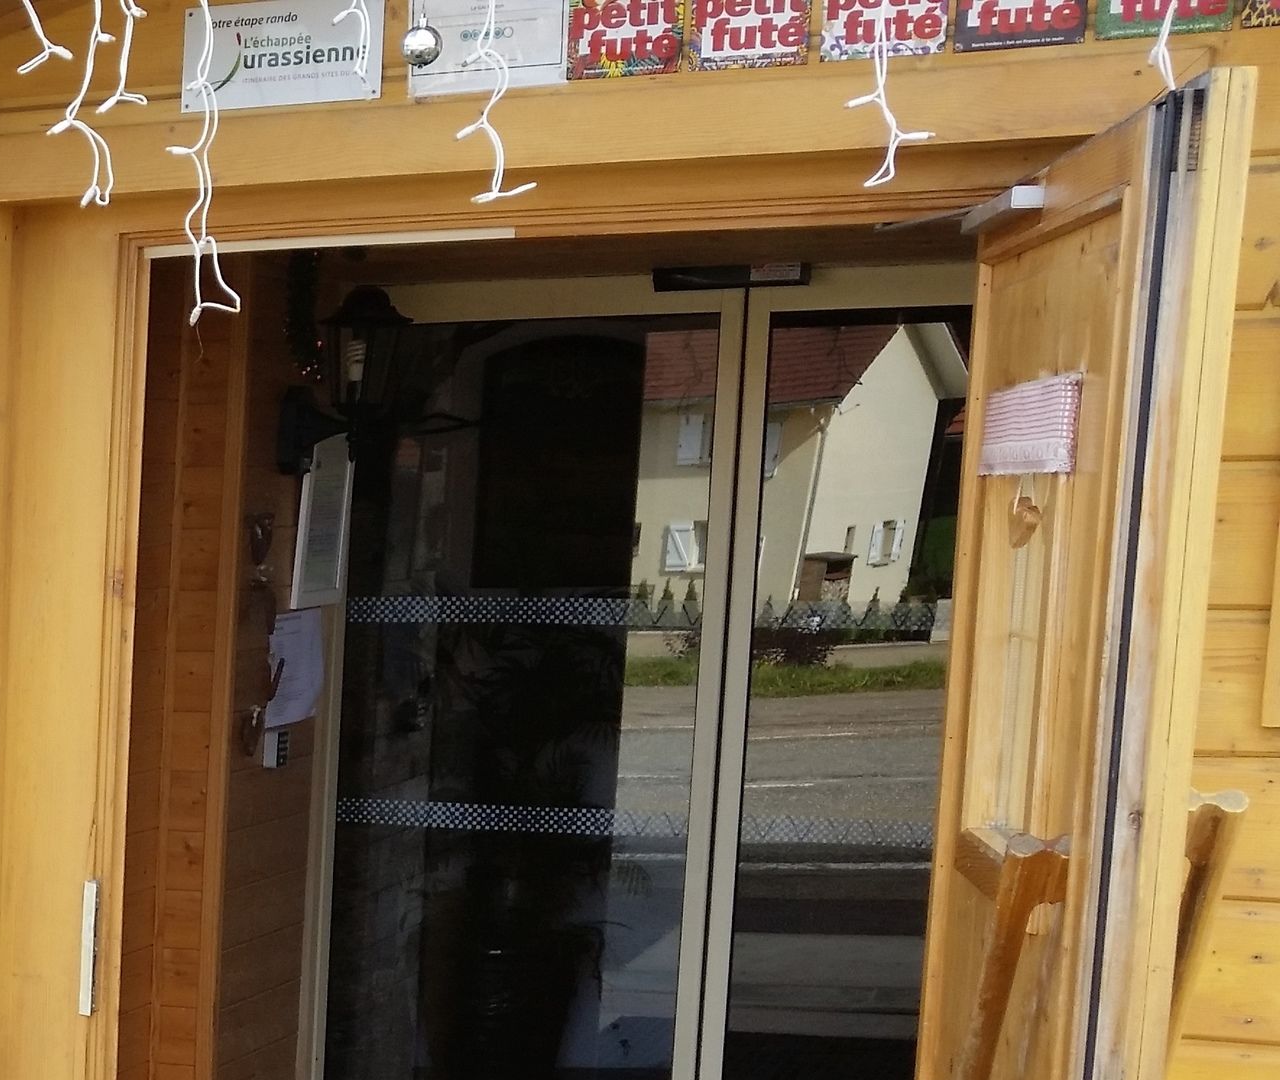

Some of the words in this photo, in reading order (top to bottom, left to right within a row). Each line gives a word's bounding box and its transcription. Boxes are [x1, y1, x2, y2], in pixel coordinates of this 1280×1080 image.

[234, 15, 264, 29] étape
[266, 12, 298, 25] rando
[711, 16, 804, 51] futé
[843, 7, 943, 44] futé
[977, 0, 1081, 35] futé
[244, 32, 312, 49] L'échappée
[588, 27, 678, 62] futé
